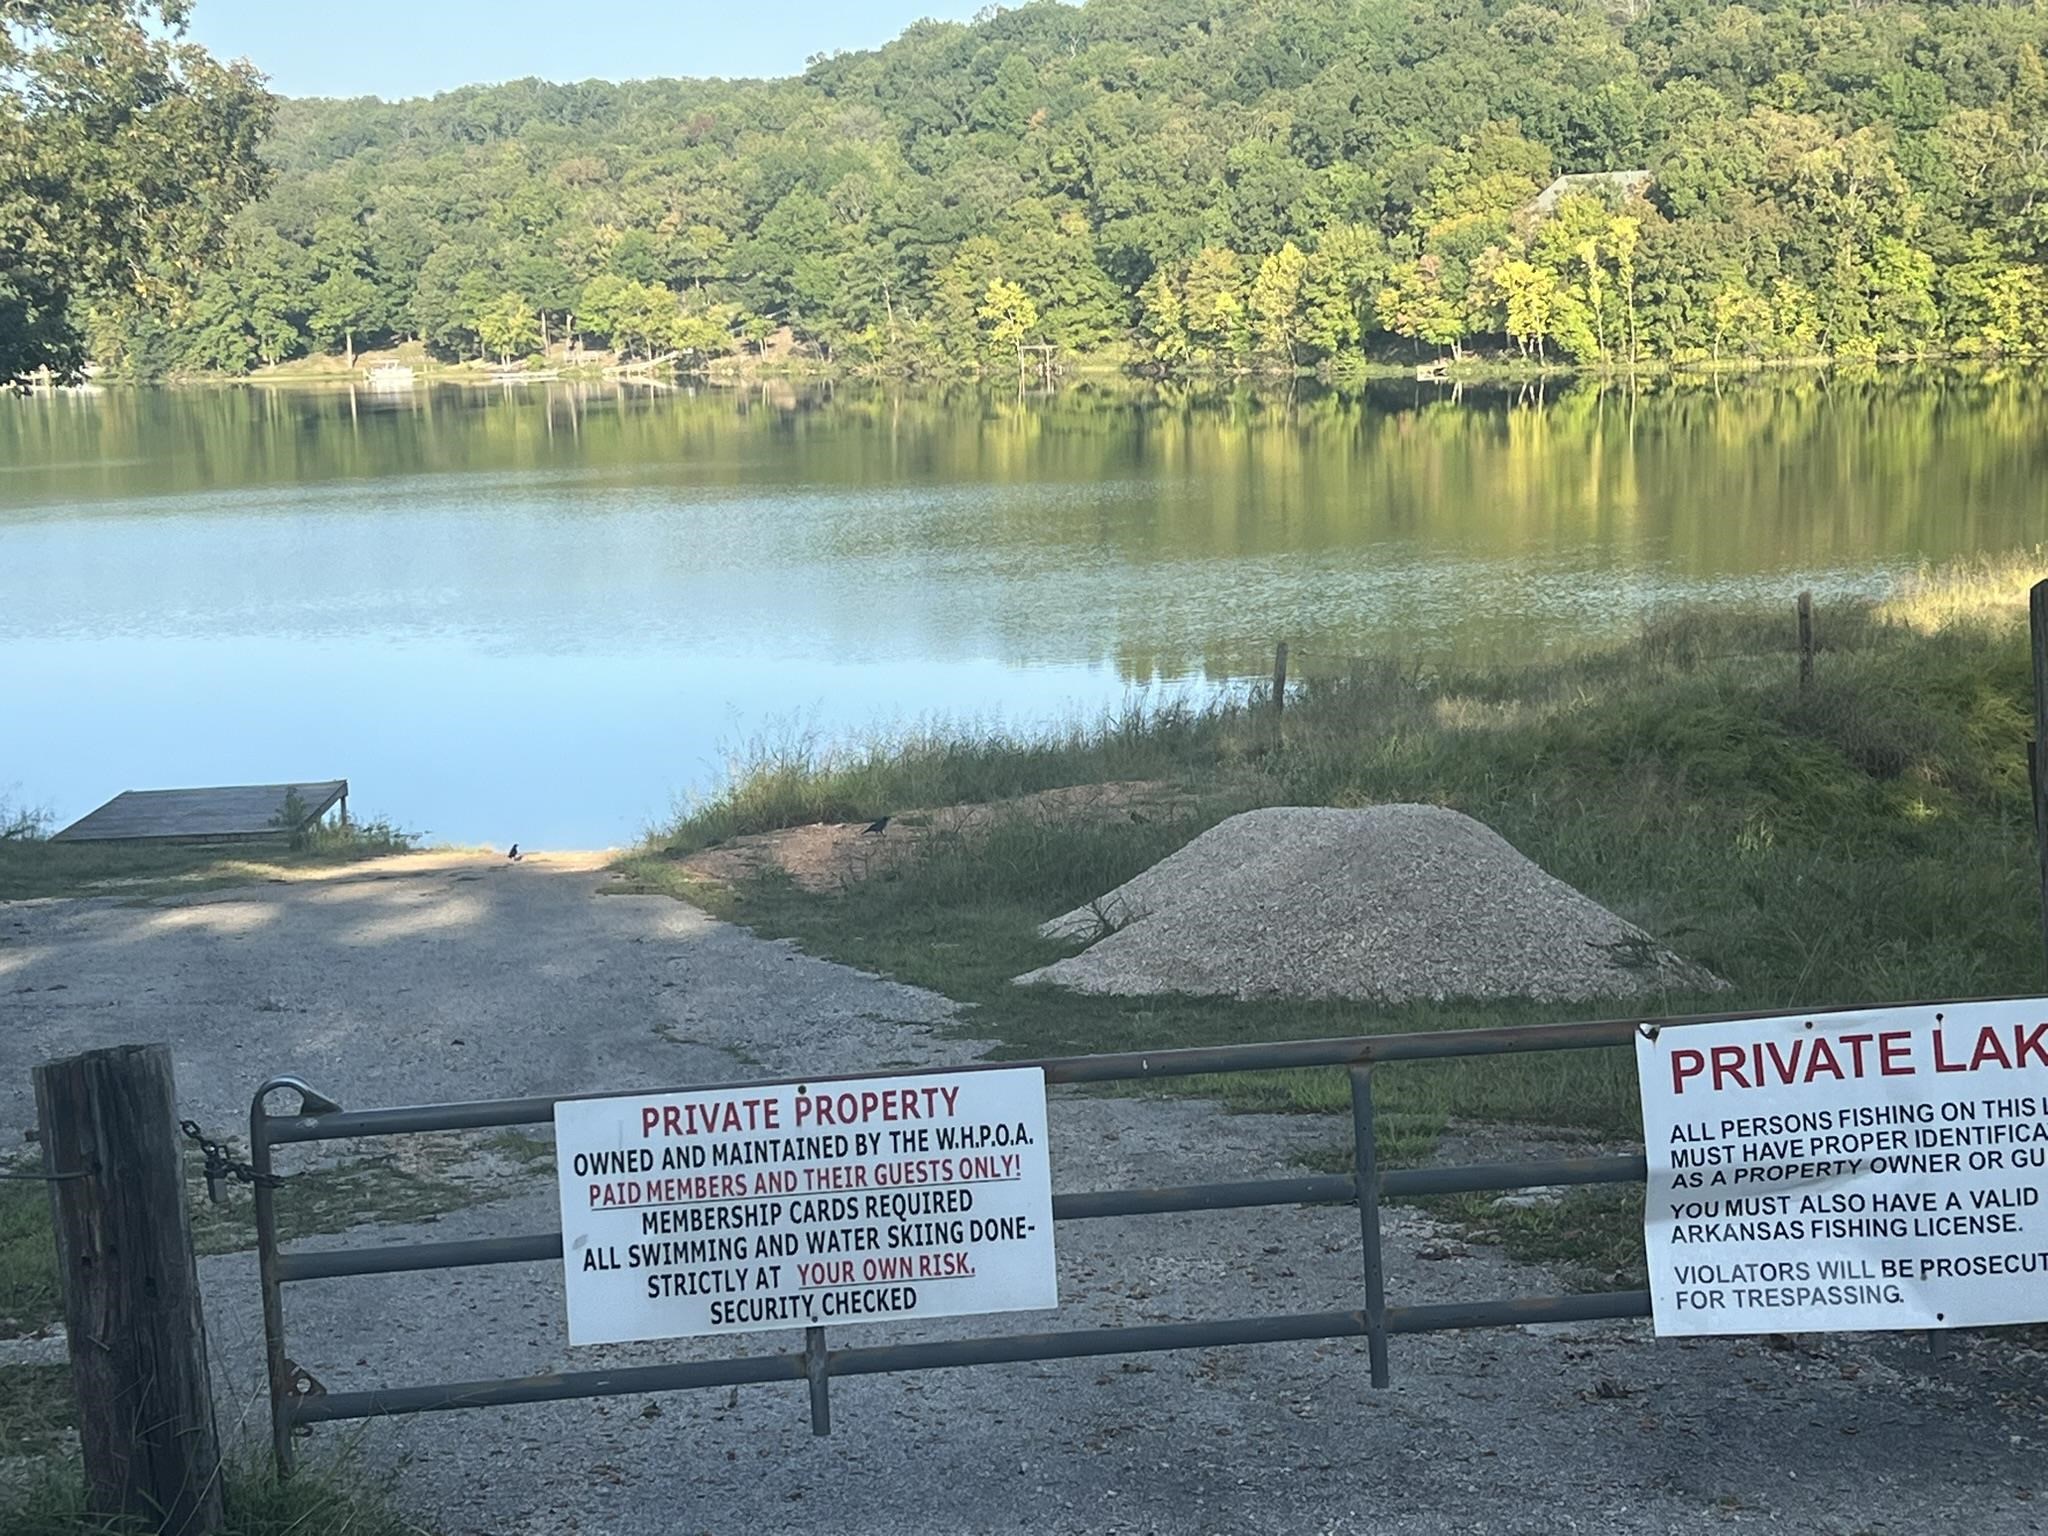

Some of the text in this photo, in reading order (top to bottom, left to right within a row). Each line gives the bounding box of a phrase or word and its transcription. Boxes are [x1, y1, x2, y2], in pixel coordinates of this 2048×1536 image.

[1670, 1030, 1917, 1095] PRIVATE
[641, 1086, 961, 1138] PRIVATE PROPERTY
[1670, 1123, 1715, 1144] ALL
[1721, 1111, 1833, 1140] PERSONS
[1838, 1104, 1935, 1128] FISHING
[1940, 1100, 1976, 1122] ON
[1982, 1096, 2036, 1119] THIS
[573, 1122, 1035, 1177] OWNED AND MAINTAINED BY THE W.H.P.O.A.
[1670, 1122, 2048, 1168] MUST HAVE PROPER IDENTIFICA
[588, 1154, 1022, 1207] PAID MEMBERS AND THEIR GUESTS ONLY!
[1671, 1170, 1703, 1189] AS
[1710, 1169, 1727, 1186] A
[1734, 1157, 1863, 1184] PROPERTY
[1869, 1152, 1962, 1174] OWNER
[1969, 1149, 2004, 1170] OR
[641, 1189, 974, 1235] MEMBERSHIP CARDS REQUIRED
[1670, 1186, 2039, 1220] YOU MUST ALSO HAVE A VALID
[583, 1215, 1036, 1272] ALL SWIMMING AND WATER SKIING DONE-
[1671, 1213, 2024, 1244] ARKANSAS FISHING LICENSE.
[647, 1252, 977, 1299] STRICTLY AT YOUR OWN RISK.
[1673, 1262, 1810, 1285] VIOLATORS
[1817, 1259, 1875, 1281] WILL
[1881, 1258, 1914, 1279] BE
[710, 1286, 917, 1325] SECURITY CHECKED
[1675, 1284, 1905, 1310] FOR TRESPASSING.
